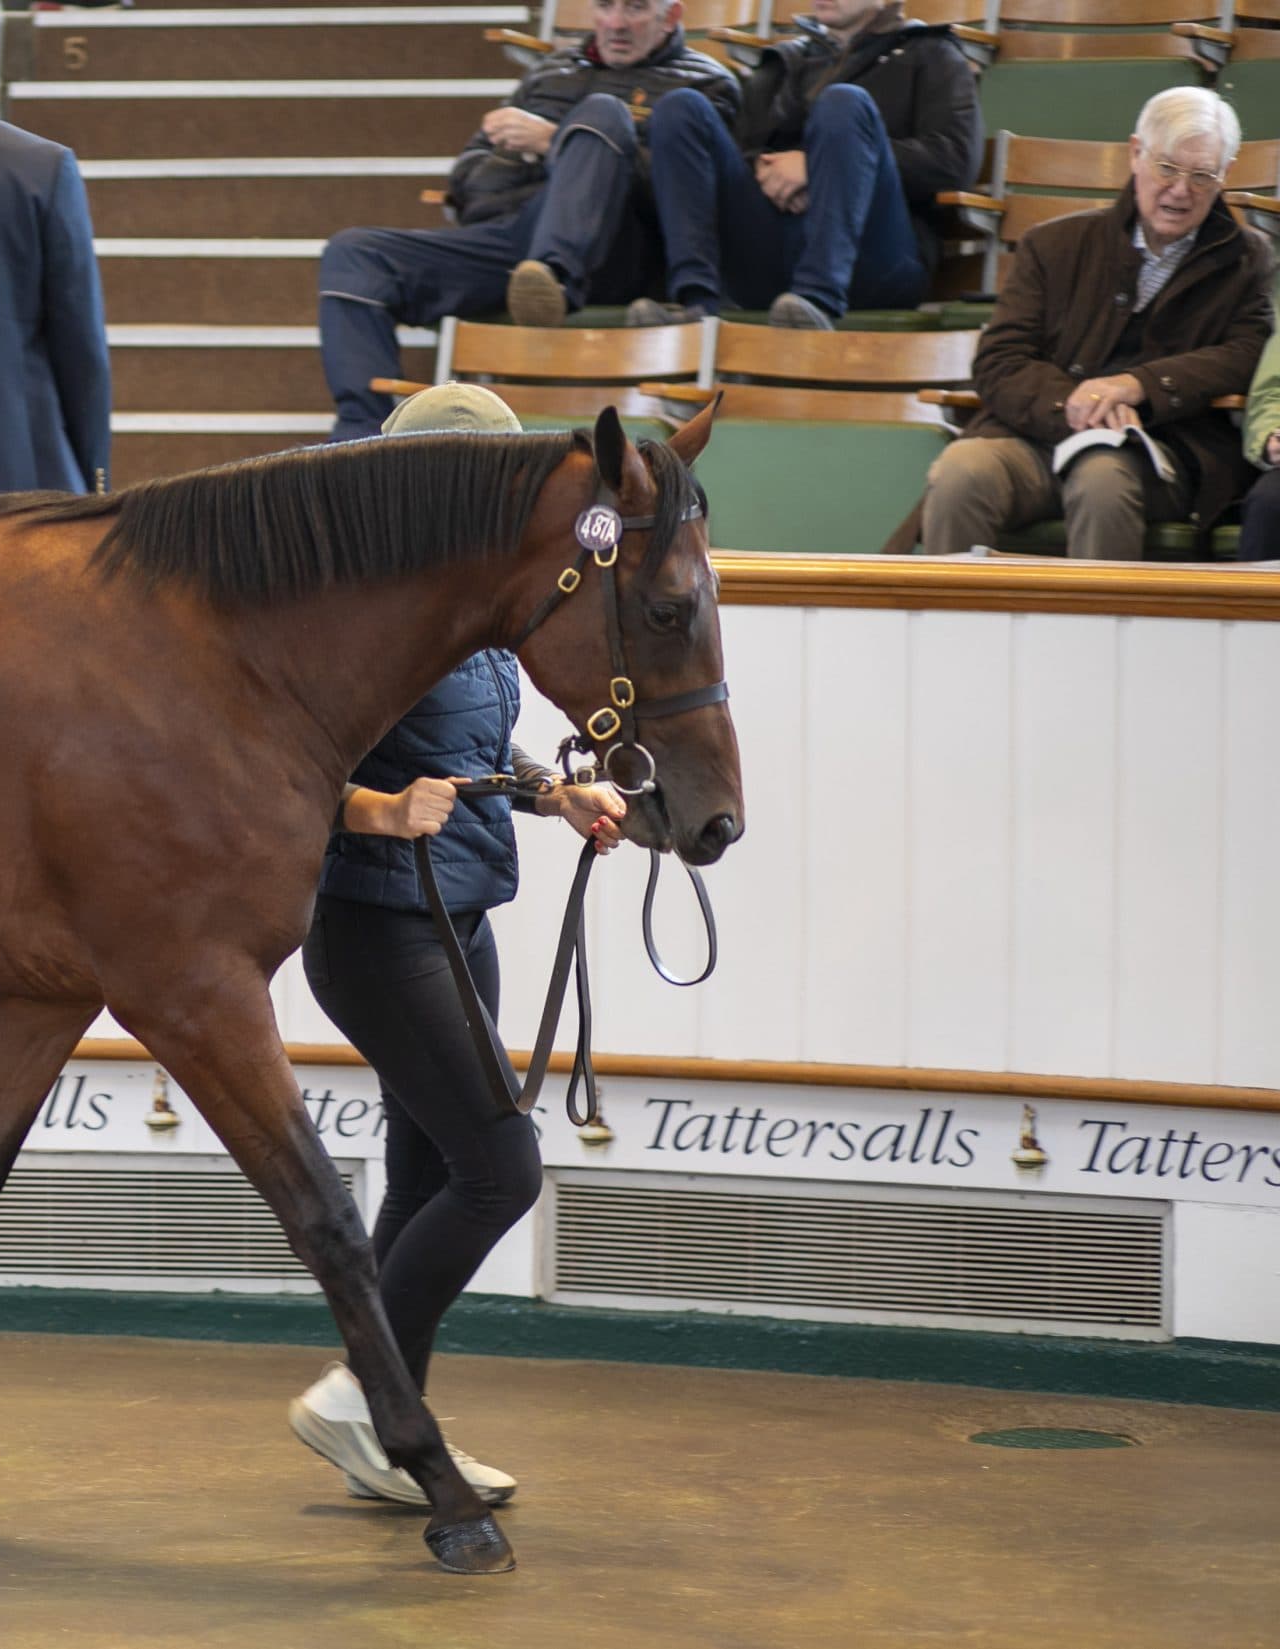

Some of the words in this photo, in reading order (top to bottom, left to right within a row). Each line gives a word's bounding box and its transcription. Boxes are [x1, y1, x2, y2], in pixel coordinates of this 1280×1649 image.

[63, 36, 88, 70] 5
[581, 514, 616, 543] 487A
[644, 1098, 982, 1168] Tattersalls
